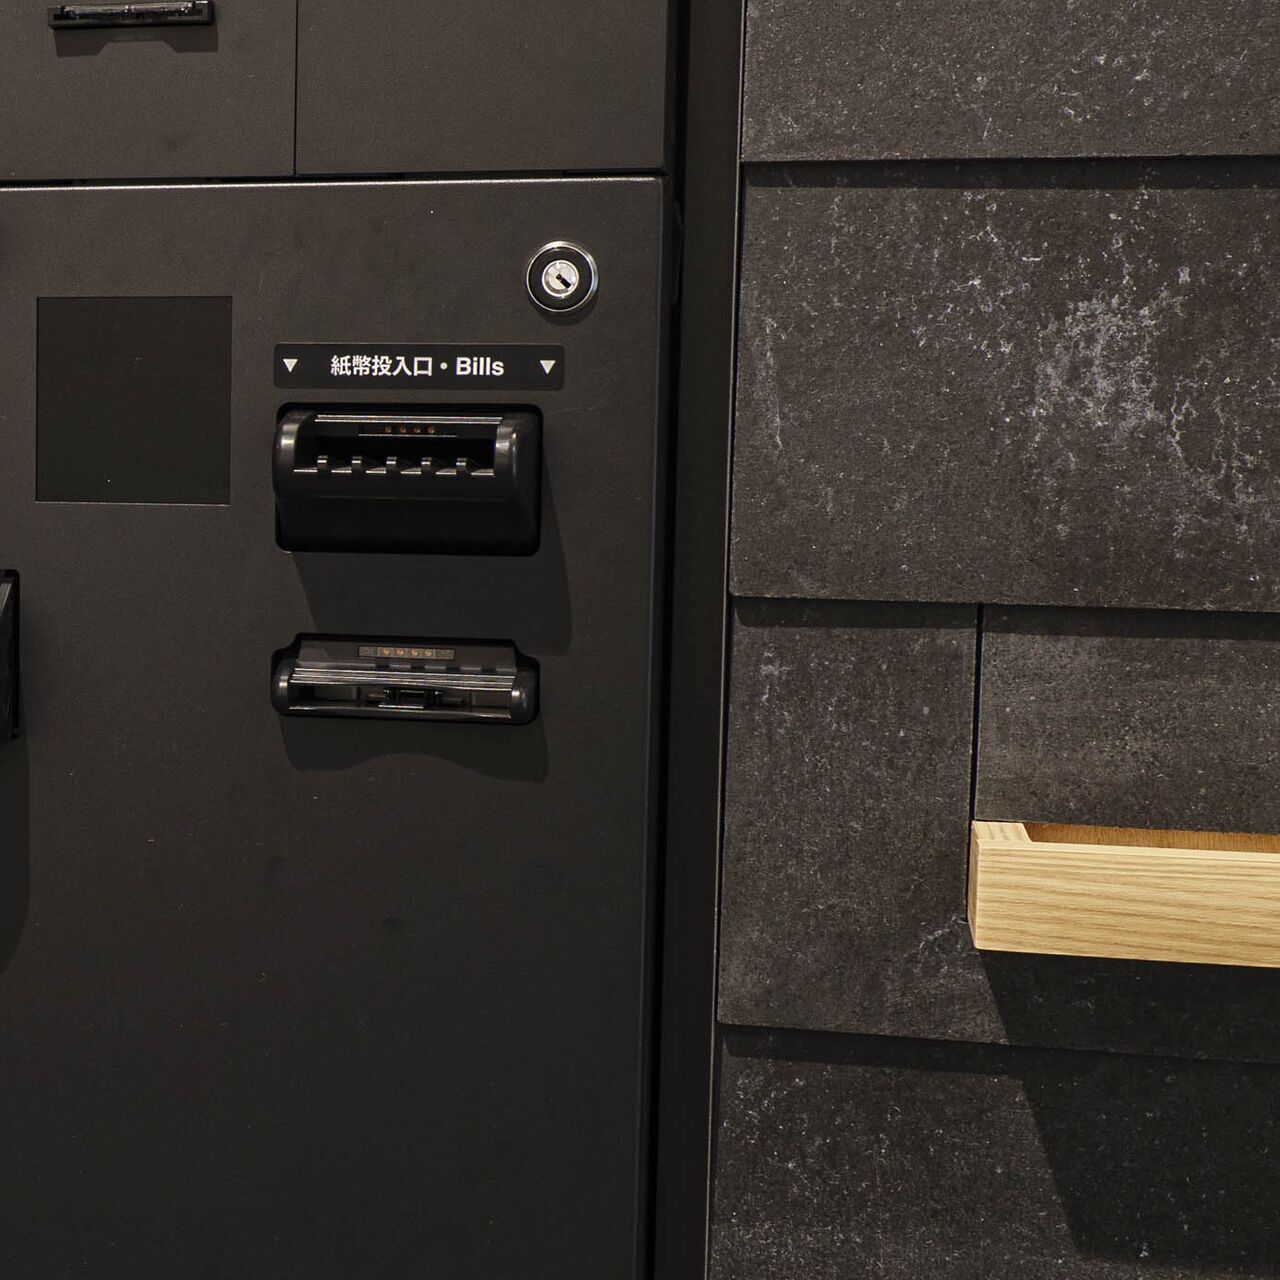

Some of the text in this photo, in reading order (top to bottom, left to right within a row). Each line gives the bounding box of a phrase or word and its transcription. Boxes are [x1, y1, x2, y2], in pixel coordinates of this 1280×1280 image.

[330, 354, 505, 378] 紙幣投入口・Bills
